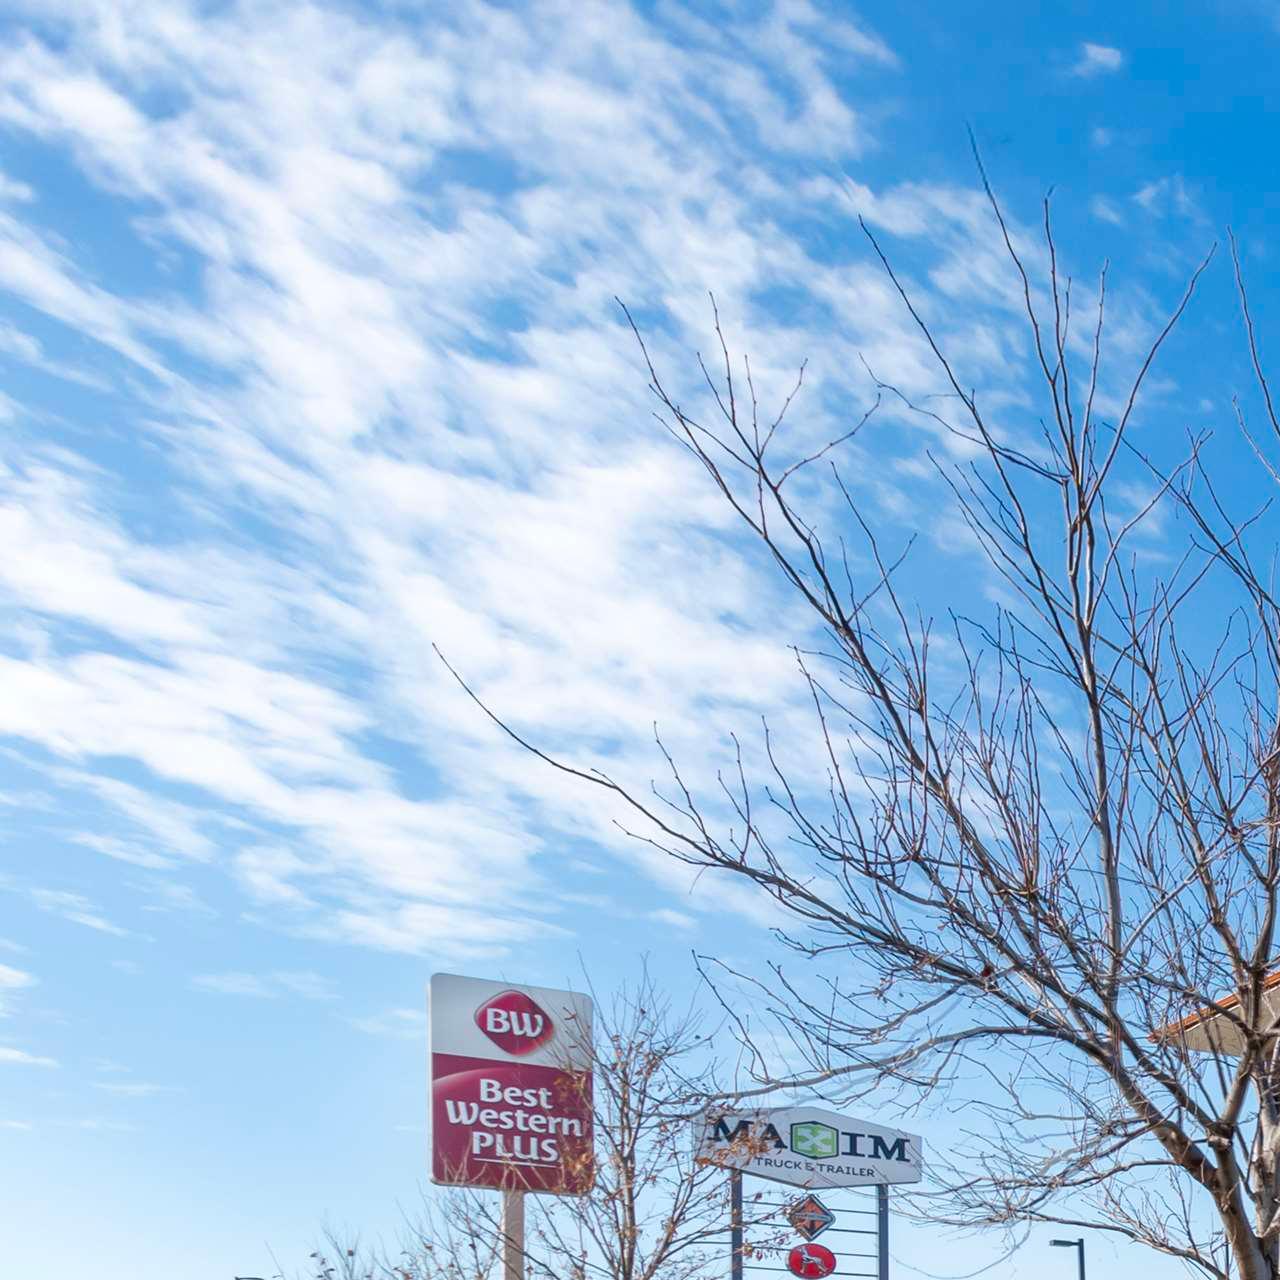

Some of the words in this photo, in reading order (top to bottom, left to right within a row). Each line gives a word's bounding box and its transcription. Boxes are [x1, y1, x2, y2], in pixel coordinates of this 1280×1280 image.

[486, 1007, 544, 1038] BW
[480, 1078, 553, 1109] Best
[446, 1099, 583, 1137] Western
[472, 1131, 560, 1162] PLUS
[707, 1119, 911, 1163] MAXIM
[755, 1157, 805, 1171] TRUCK
[806, 1161, 815, 1172] &
[816, 1163, 876, 1178] TRAILER
